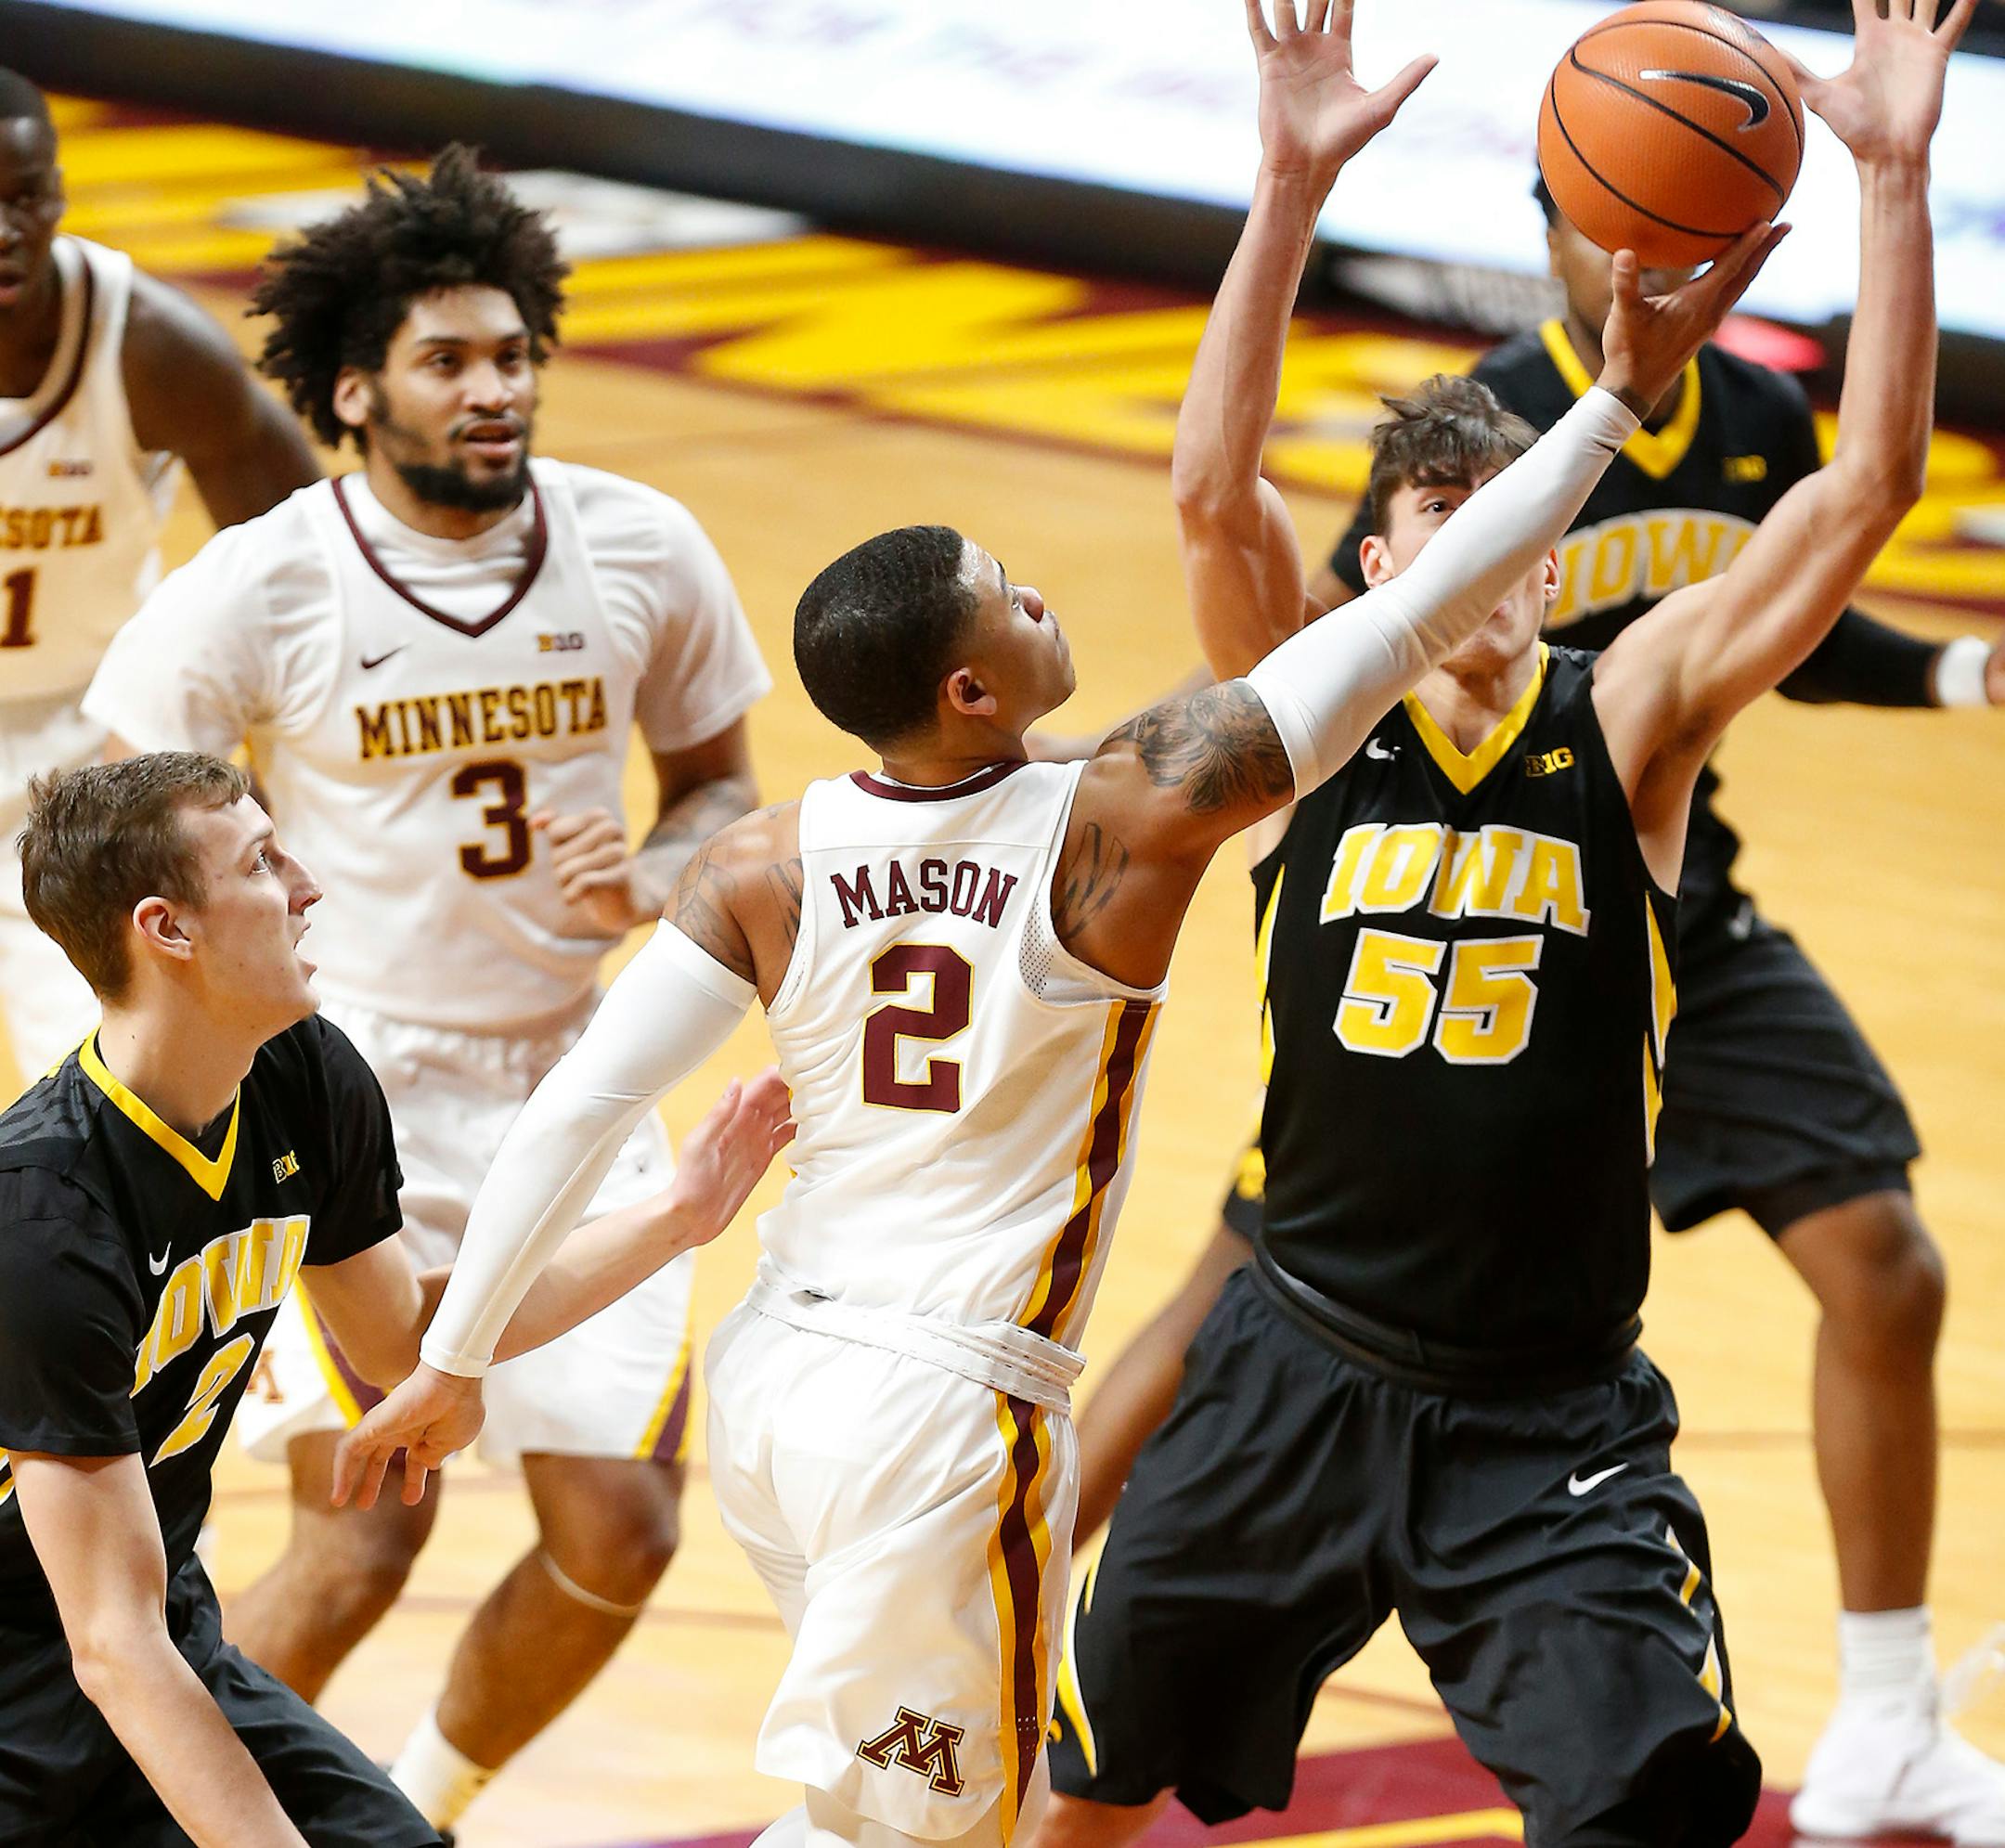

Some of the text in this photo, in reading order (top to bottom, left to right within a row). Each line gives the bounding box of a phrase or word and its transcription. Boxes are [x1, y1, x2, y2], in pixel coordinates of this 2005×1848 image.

[0, 505, 103, 549] SOTA
[355, 676, 607, 760] MINNESOTA
[449, 756, 532, 882] 3
[830, 859, 1018, 928] MASON
[1318, 821, 1592, 937] IOWA
[861, 941, 975, 1114] 2
[1332, 927, 1545, 1066] 55
[148, 1332, 256, 1469] 2
[856, 1705, 965, 1798] M
